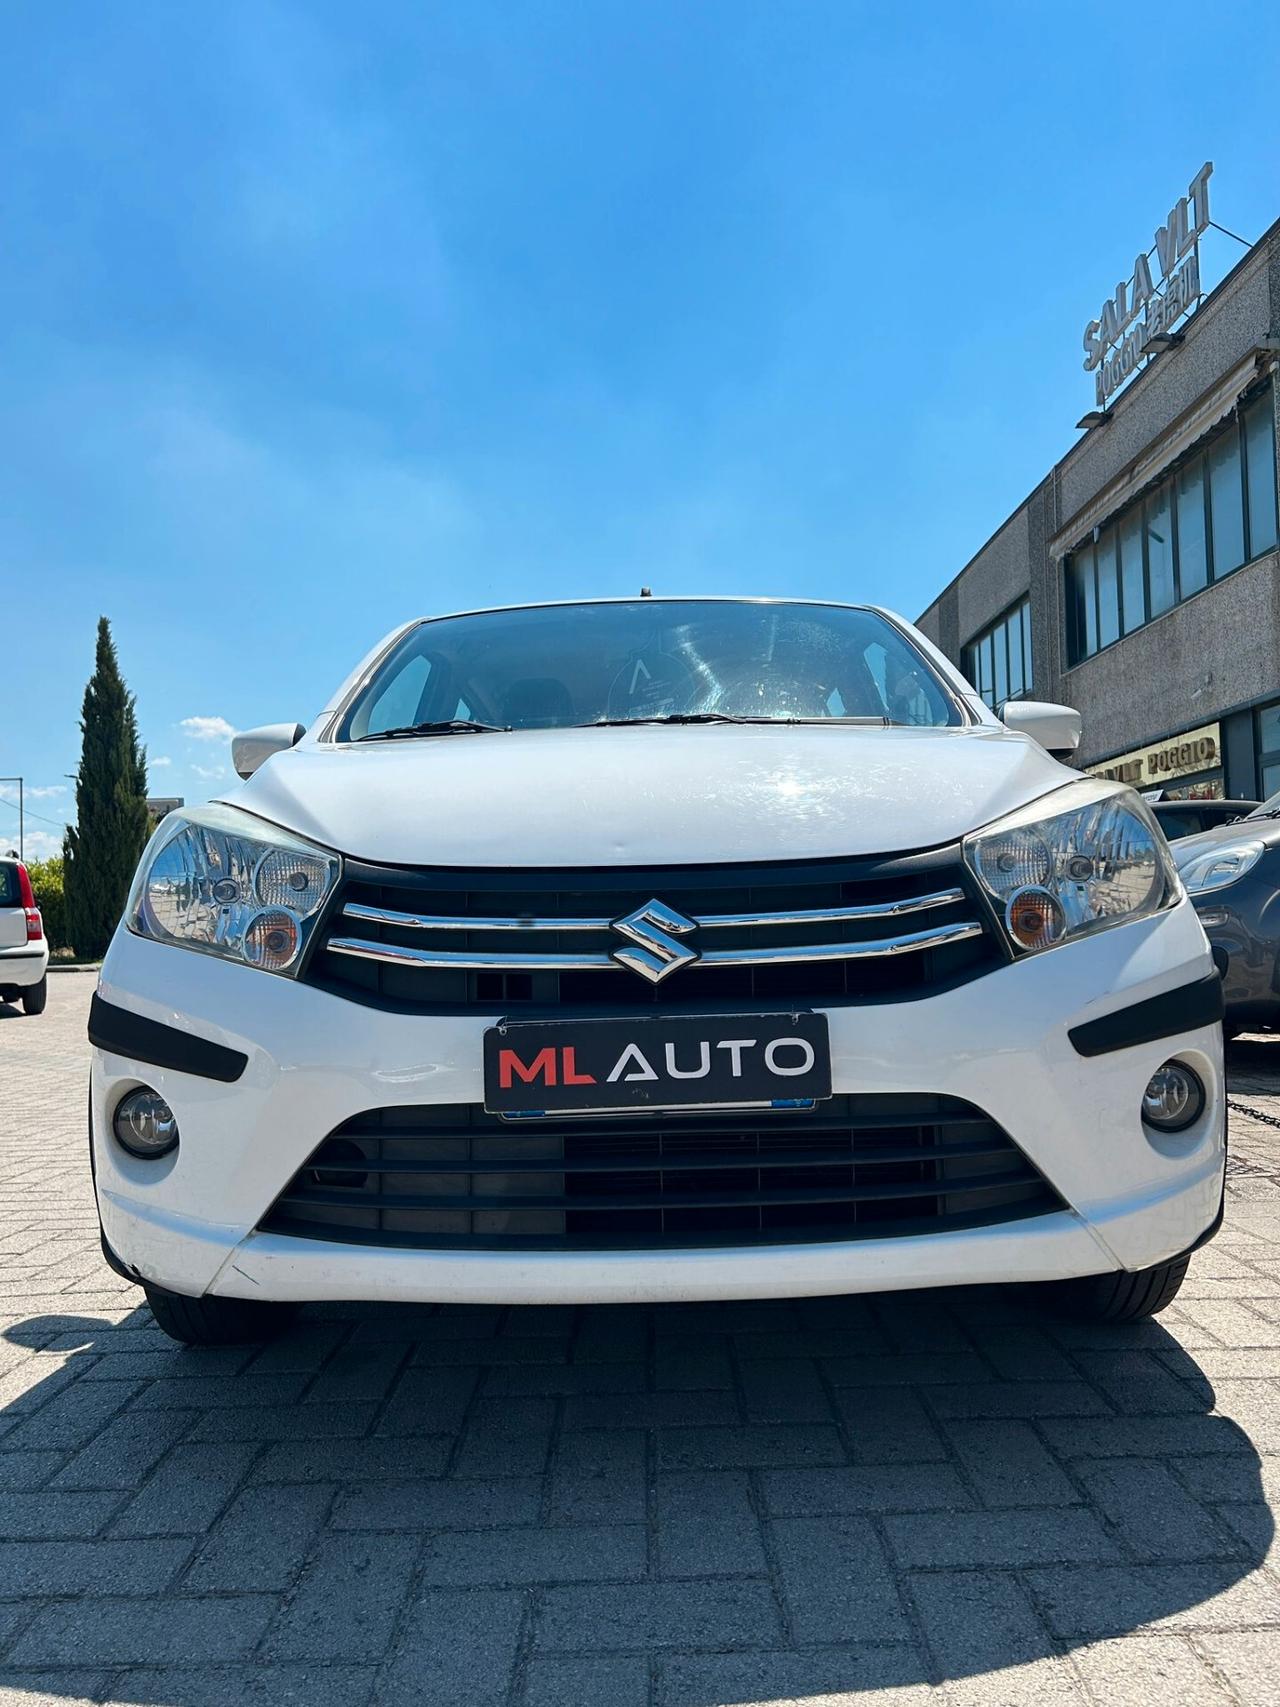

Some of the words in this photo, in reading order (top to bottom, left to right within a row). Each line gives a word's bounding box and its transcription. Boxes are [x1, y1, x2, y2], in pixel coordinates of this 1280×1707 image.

[1083, 253, 1155, 371] SALA
[1155, 161, 1213, 277] VLT
[1095, 322, 1148, 407] POGGIO
[1147, 736, 1216, 775] POGGIO
[499, 1046, 598, 1089] ML
[606, 1037, 816, 1083] AUTO
